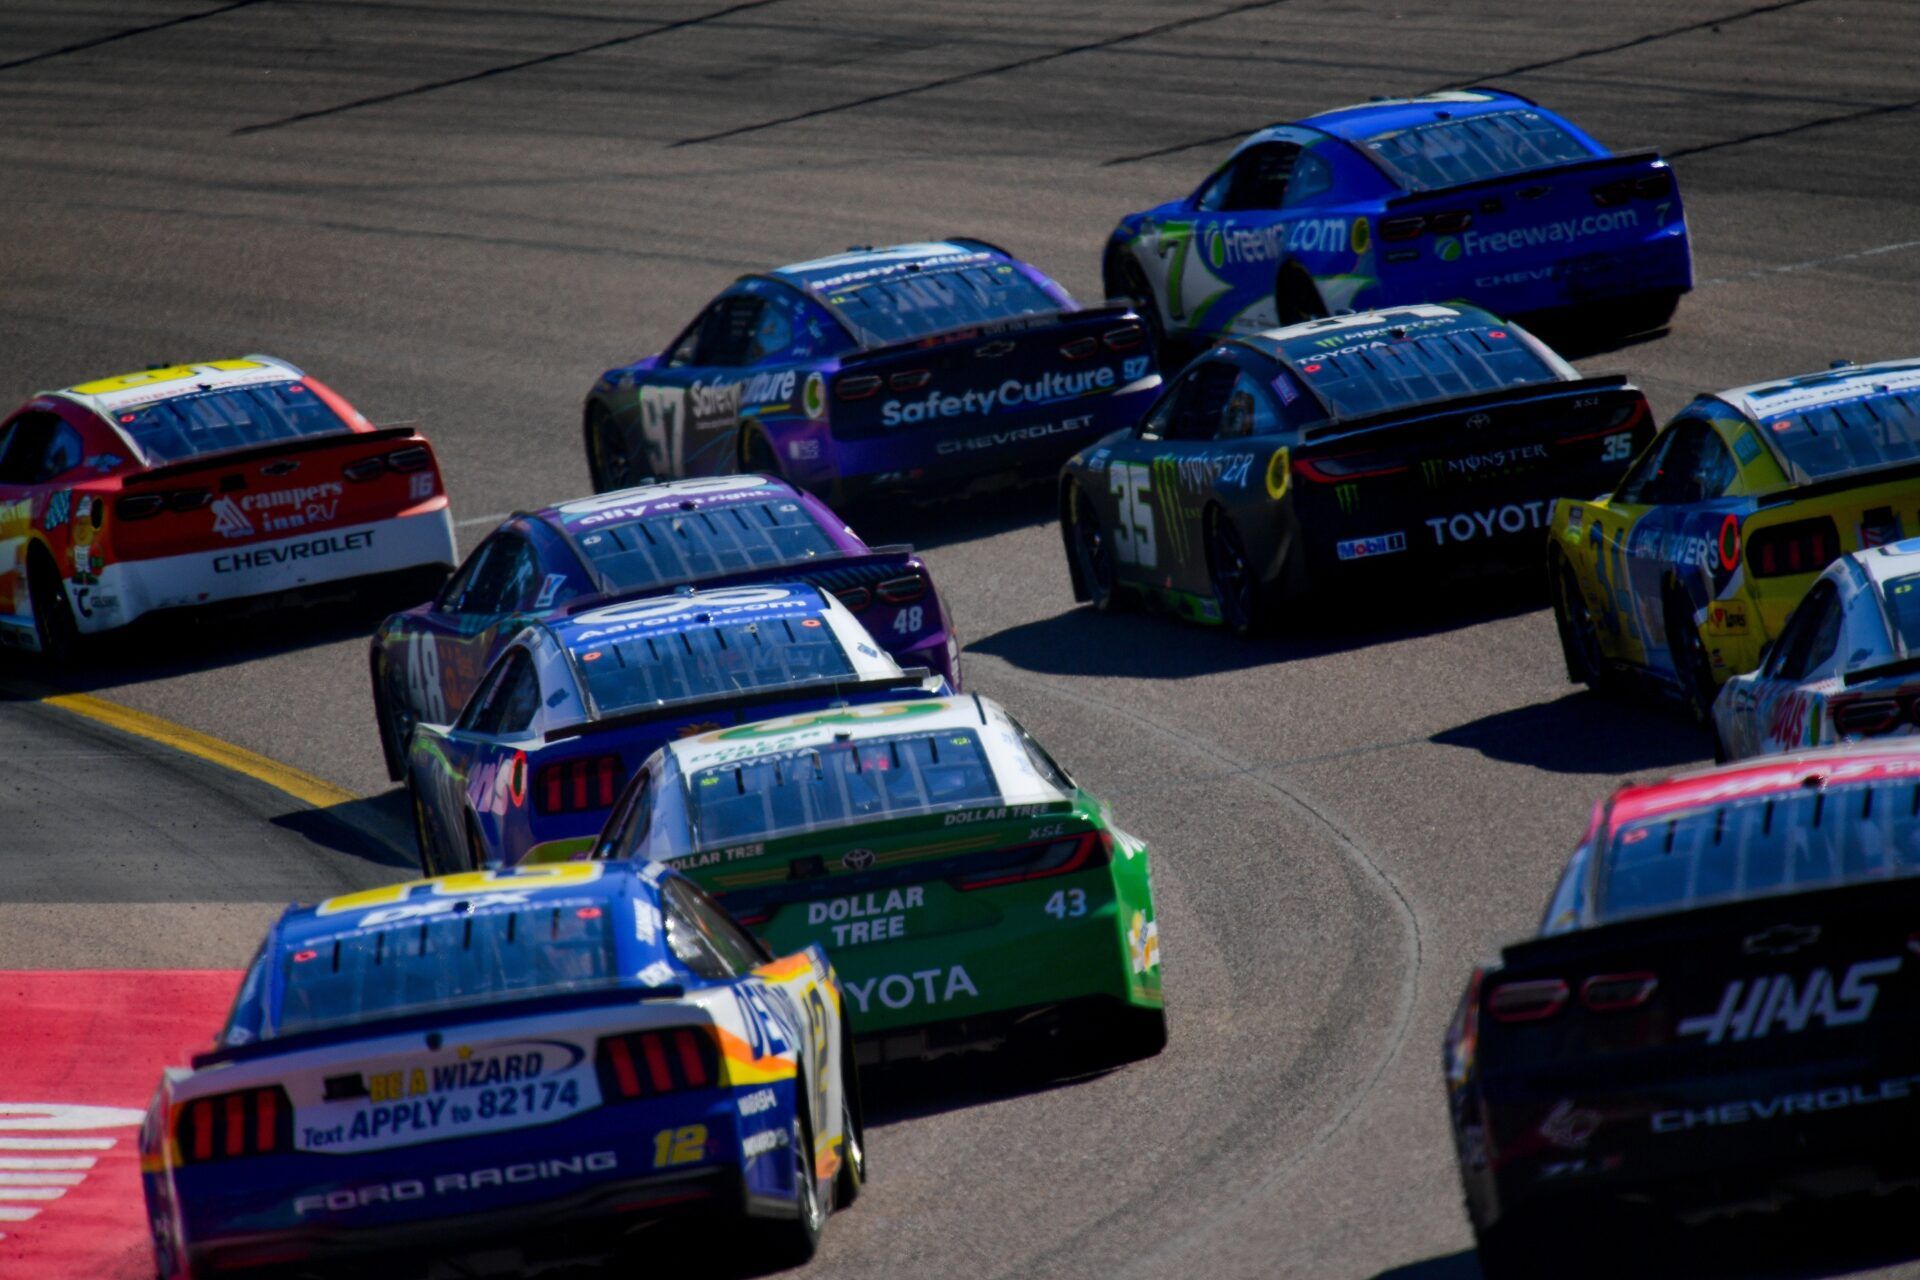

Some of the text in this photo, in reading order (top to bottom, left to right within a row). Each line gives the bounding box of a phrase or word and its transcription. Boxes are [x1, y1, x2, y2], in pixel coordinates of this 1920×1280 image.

[1655, 202, 1671, 226] 7
[1462, 208, 1639, 257] Freeway.com
[1122, 356, 1149, 380] 97
[1296, 340, 1388, 365] TOYOTA
[881, 365, 1115, 428] SafetyCulture
[937, 414, 1095, 455] CHEVROLET
[1601, 432, 1634, 463] 35
[1447, 443, 1549, 474] MONSTER
[240, 481, 343, 512] campers
[409, 471, 434, 499] 16
[262, 499, 339, 533] inn RV
[579, 505, 647, 525] ally
[1110, 459, 1158, 569] 35
[213, 530, 375, 573] CHEVROLET
[1339, 535, 1386, 560] Mobil
[576, 600, 807, 642] Aaron.com
[893, 605, 924, 635] 48
[943, 808, 1008, 827] DOLLAR
[667, 842, 766, 871] OLLAR TREE
[808, 886, 925, 926] DOLLAR
[1044, 887, 1088, 919] 43
[831, 915, 906, 947] TREE
[844, 964, 979, 1014] YOTA
[1675, 956, 1903, 1045] HAAS
[369, 1052, 544, 1103] BE A WIZARD
[303, 1078, 580, 1148] Text APPLY to 82174
[652, 1123, 709, 1168] 12
[294, 1149, 618, 1216] FORD RACING
